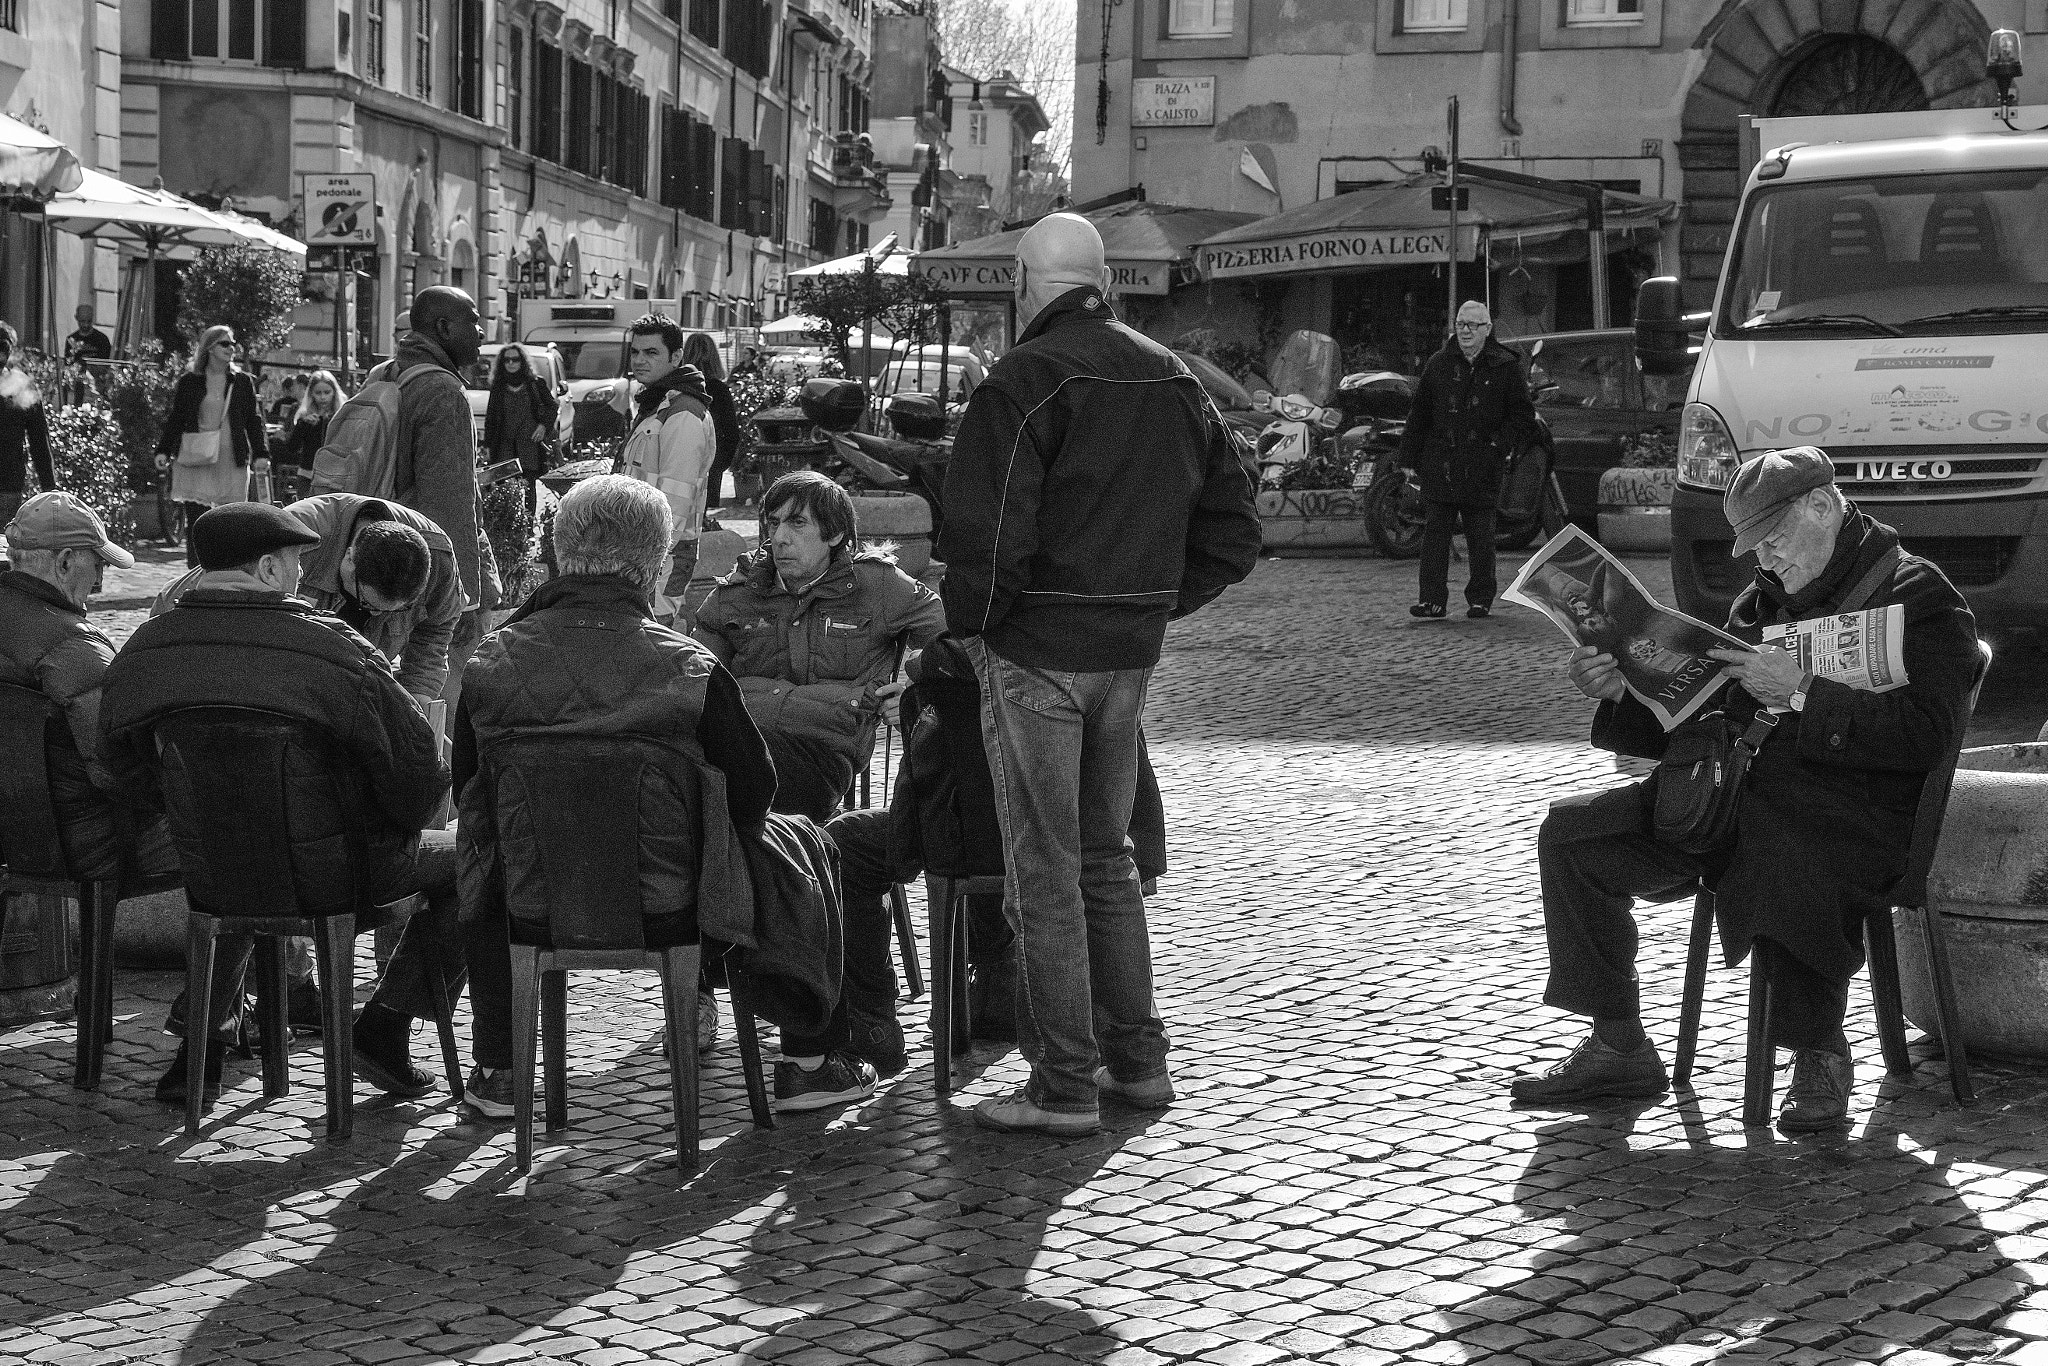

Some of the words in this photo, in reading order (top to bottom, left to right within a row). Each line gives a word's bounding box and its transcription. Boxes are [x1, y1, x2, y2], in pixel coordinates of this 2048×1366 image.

[1155, 83, 1190, 94] PIAZZA
[316, 188, 362, 197] pedonale
[1206, 245, 1295, 271] PIZZERIA
[1299, 238, 1367, 260] FORNO
[1371, 239, 1384, 255] A
[976, 266, 1016, 284] CAN
[1883, 359, 1922, 367] ROMA
[1856, 460, 1952, 481] IVECO
[1658, 641, 1732, 700] VERSAE
